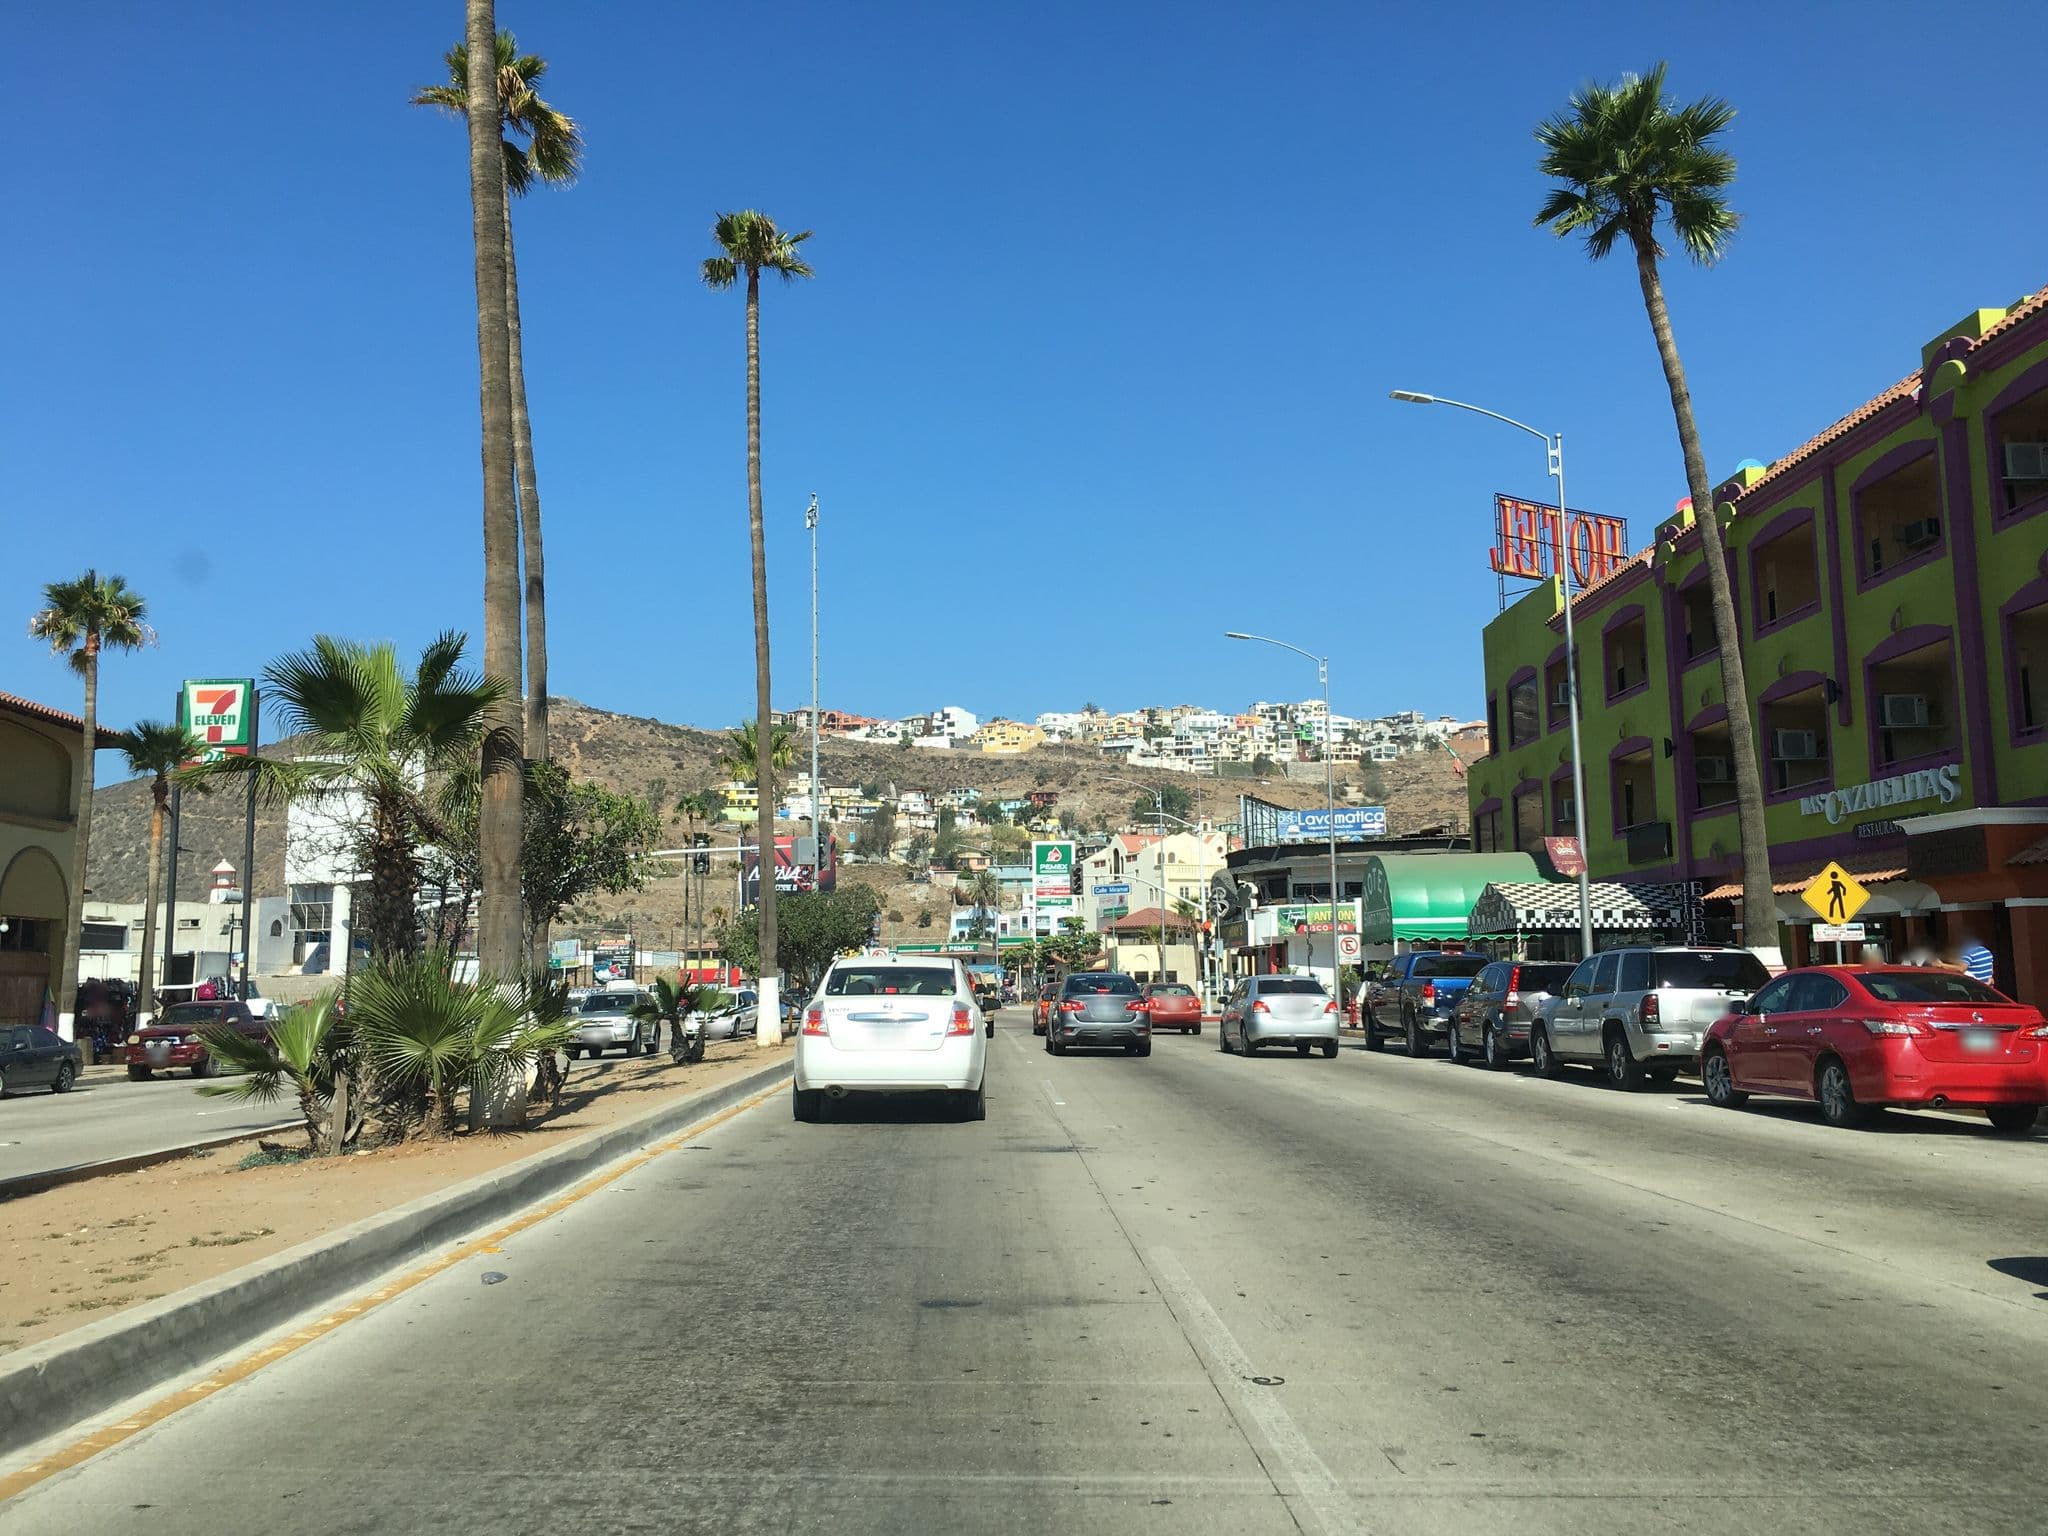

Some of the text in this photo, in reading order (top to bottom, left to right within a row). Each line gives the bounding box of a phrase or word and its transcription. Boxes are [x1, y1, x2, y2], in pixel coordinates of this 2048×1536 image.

[196, 689, 236, 743] 7
[1823, 764, 1962, 825] CAZUELITAS
[1313, 910, 1355, 921] ANTONY
